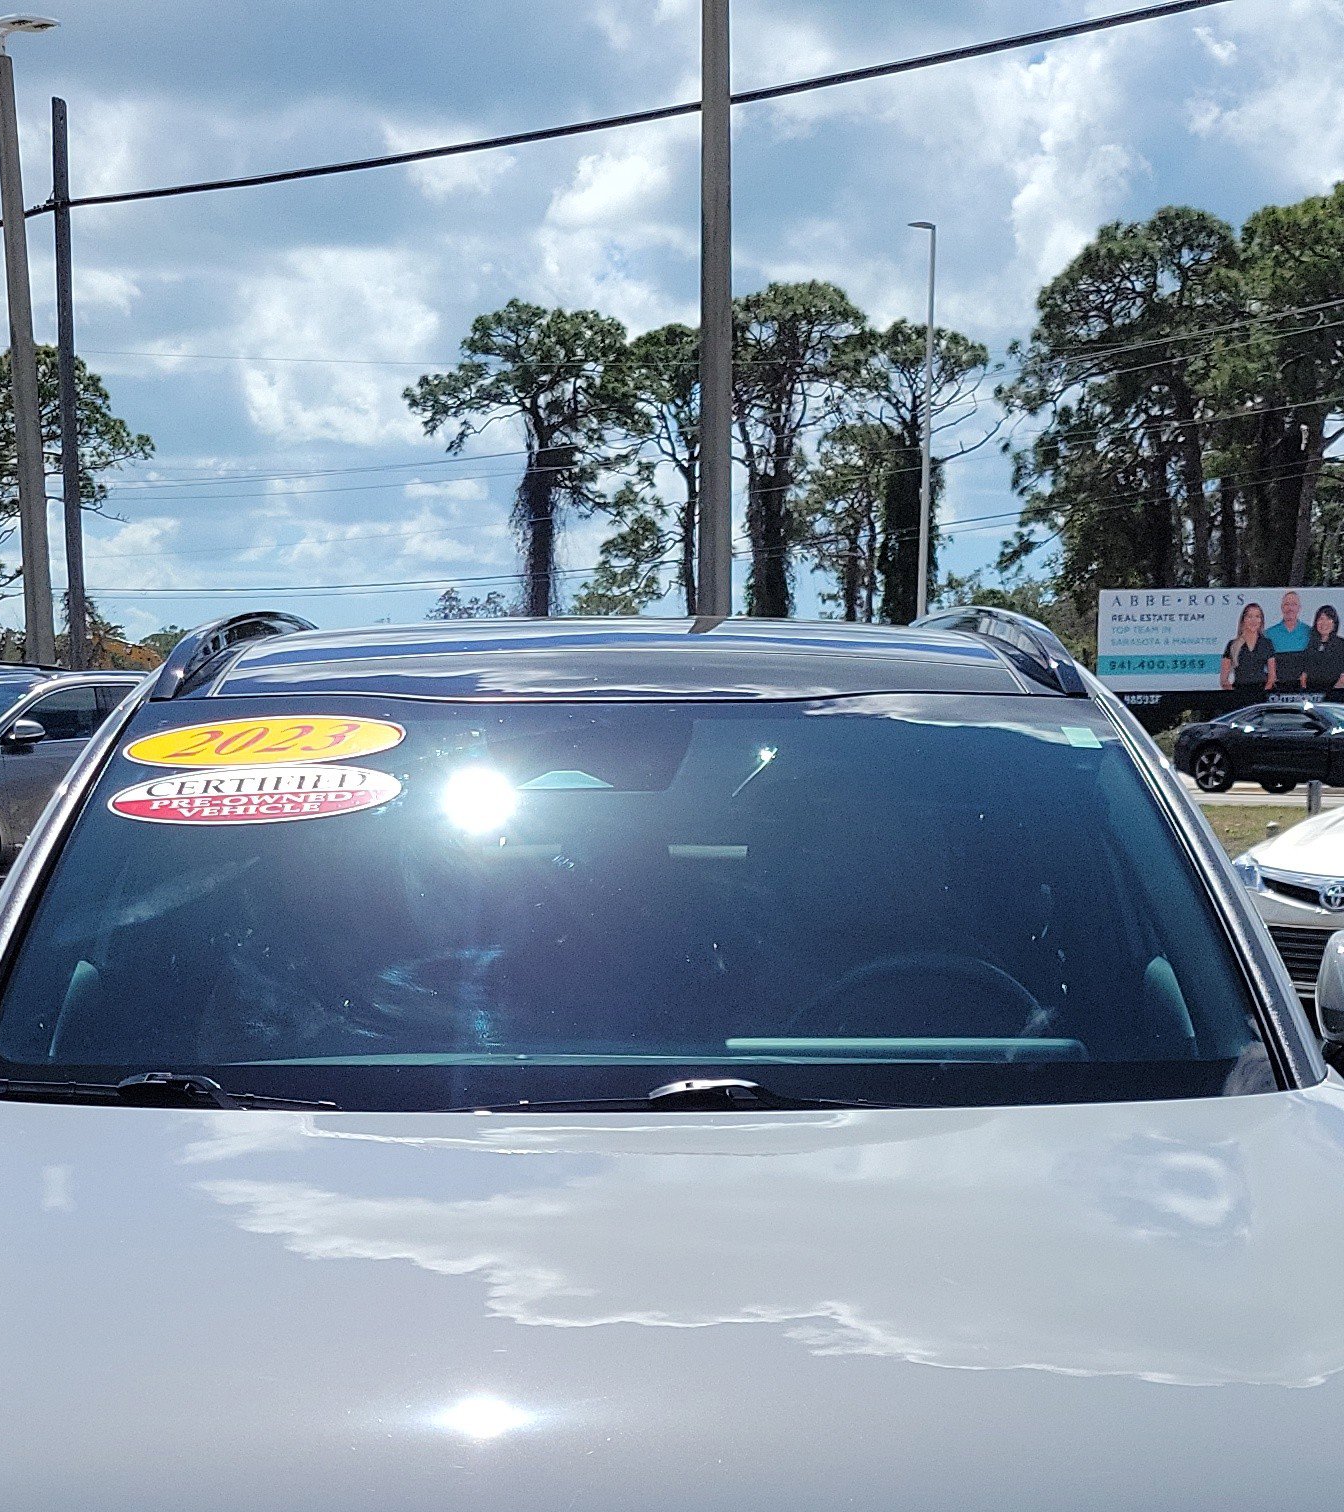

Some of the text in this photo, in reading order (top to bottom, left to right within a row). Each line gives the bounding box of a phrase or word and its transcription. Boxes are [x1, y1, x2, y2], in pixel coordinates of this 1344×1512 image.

[1111, 593, 1246, 607] ABBE ROSS
[1111, 613, 1206, 622] REAL ESTATE TEAM
[1111, 626, 1131, 635] TOP
[1133, 626, 1158, 634] TEAM
[162, 723, 361, 759] 2023
[146, 771, 371, 798] CERTIFIED
[149, 790, 354, 811] PRE-OWNED
[177, 802, 321, 819] VEHICLE
